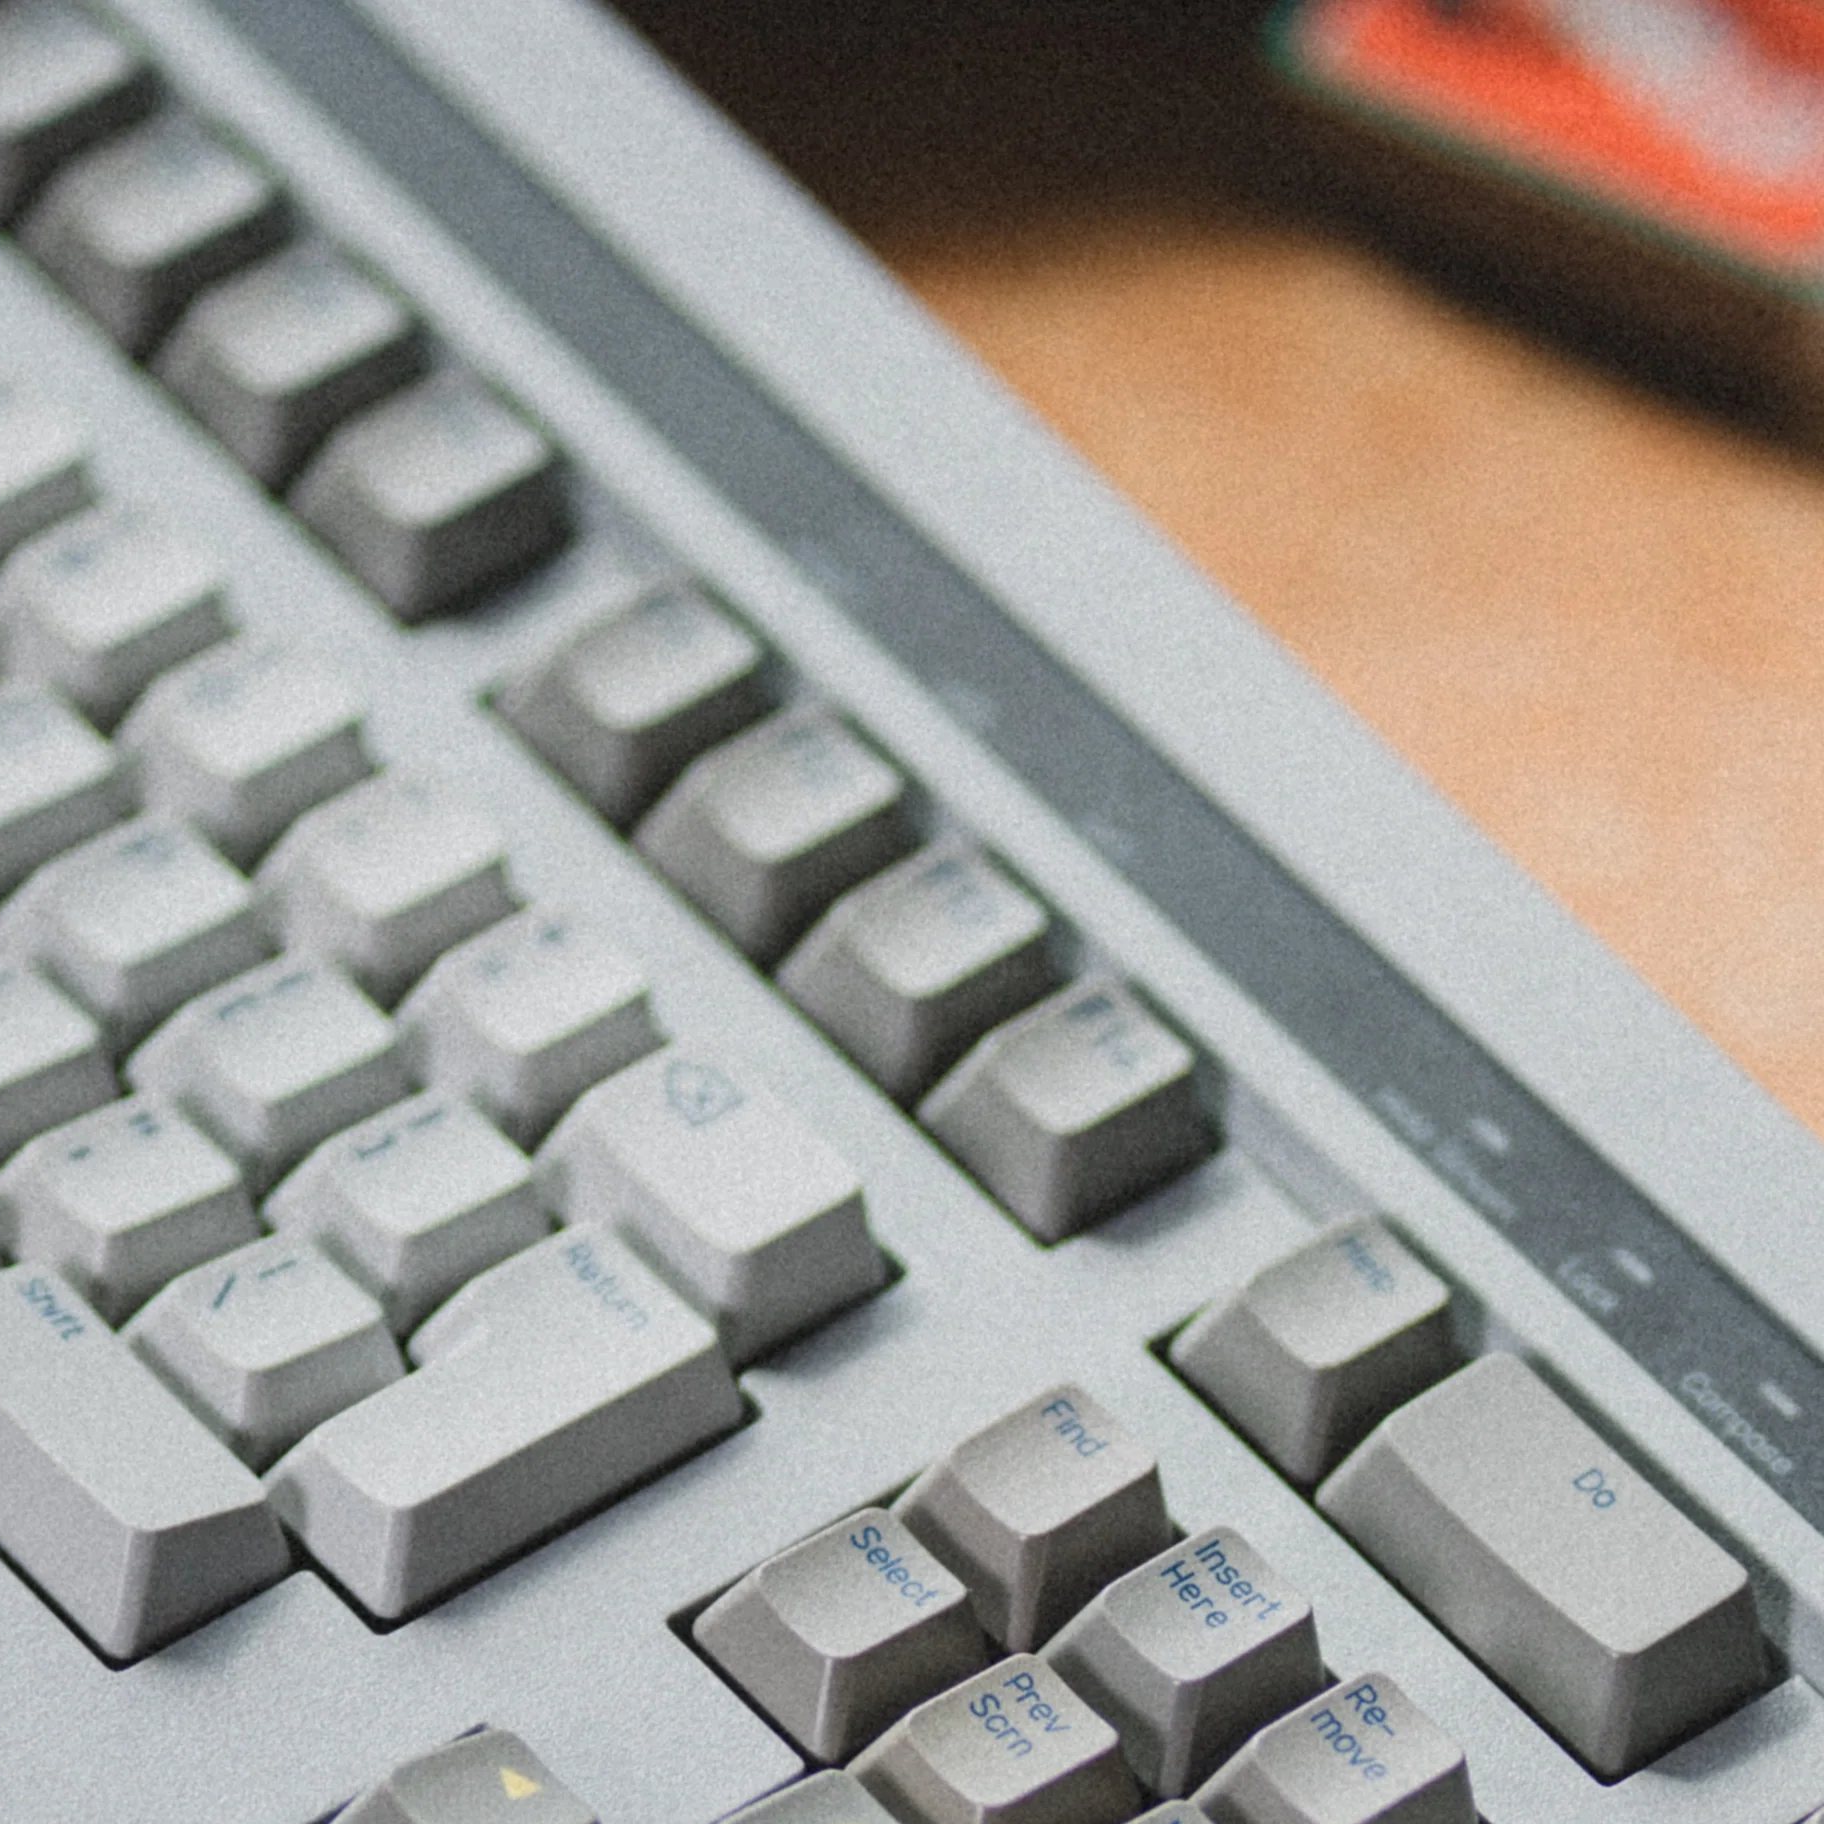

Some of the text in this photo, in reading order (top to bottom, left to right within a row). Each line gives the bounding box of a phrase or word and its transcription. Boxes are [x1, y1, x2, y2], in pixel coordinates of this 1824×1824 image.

[20, 1277, 86, 1343] Shift
[564, 1243, 650, 1332] Return
[1041, 1399, 1109, 1458] Find
[1682, 1371, 1793, 1477] Compose
[1573, 1467, 1617, 1509] Do
[850, 1526, 939, 1608] Select
[1159, 1560, 1229, 1629] Here
[1194, 1538, 1282, 1622] Insert
[969, 1693, 1034, 1758] Scrn
[1003, 1672, 1072, 1734] Prev
[1344, 1683, 1396, 1737] Re-
[1310, 1708, 1387, 1782] move
